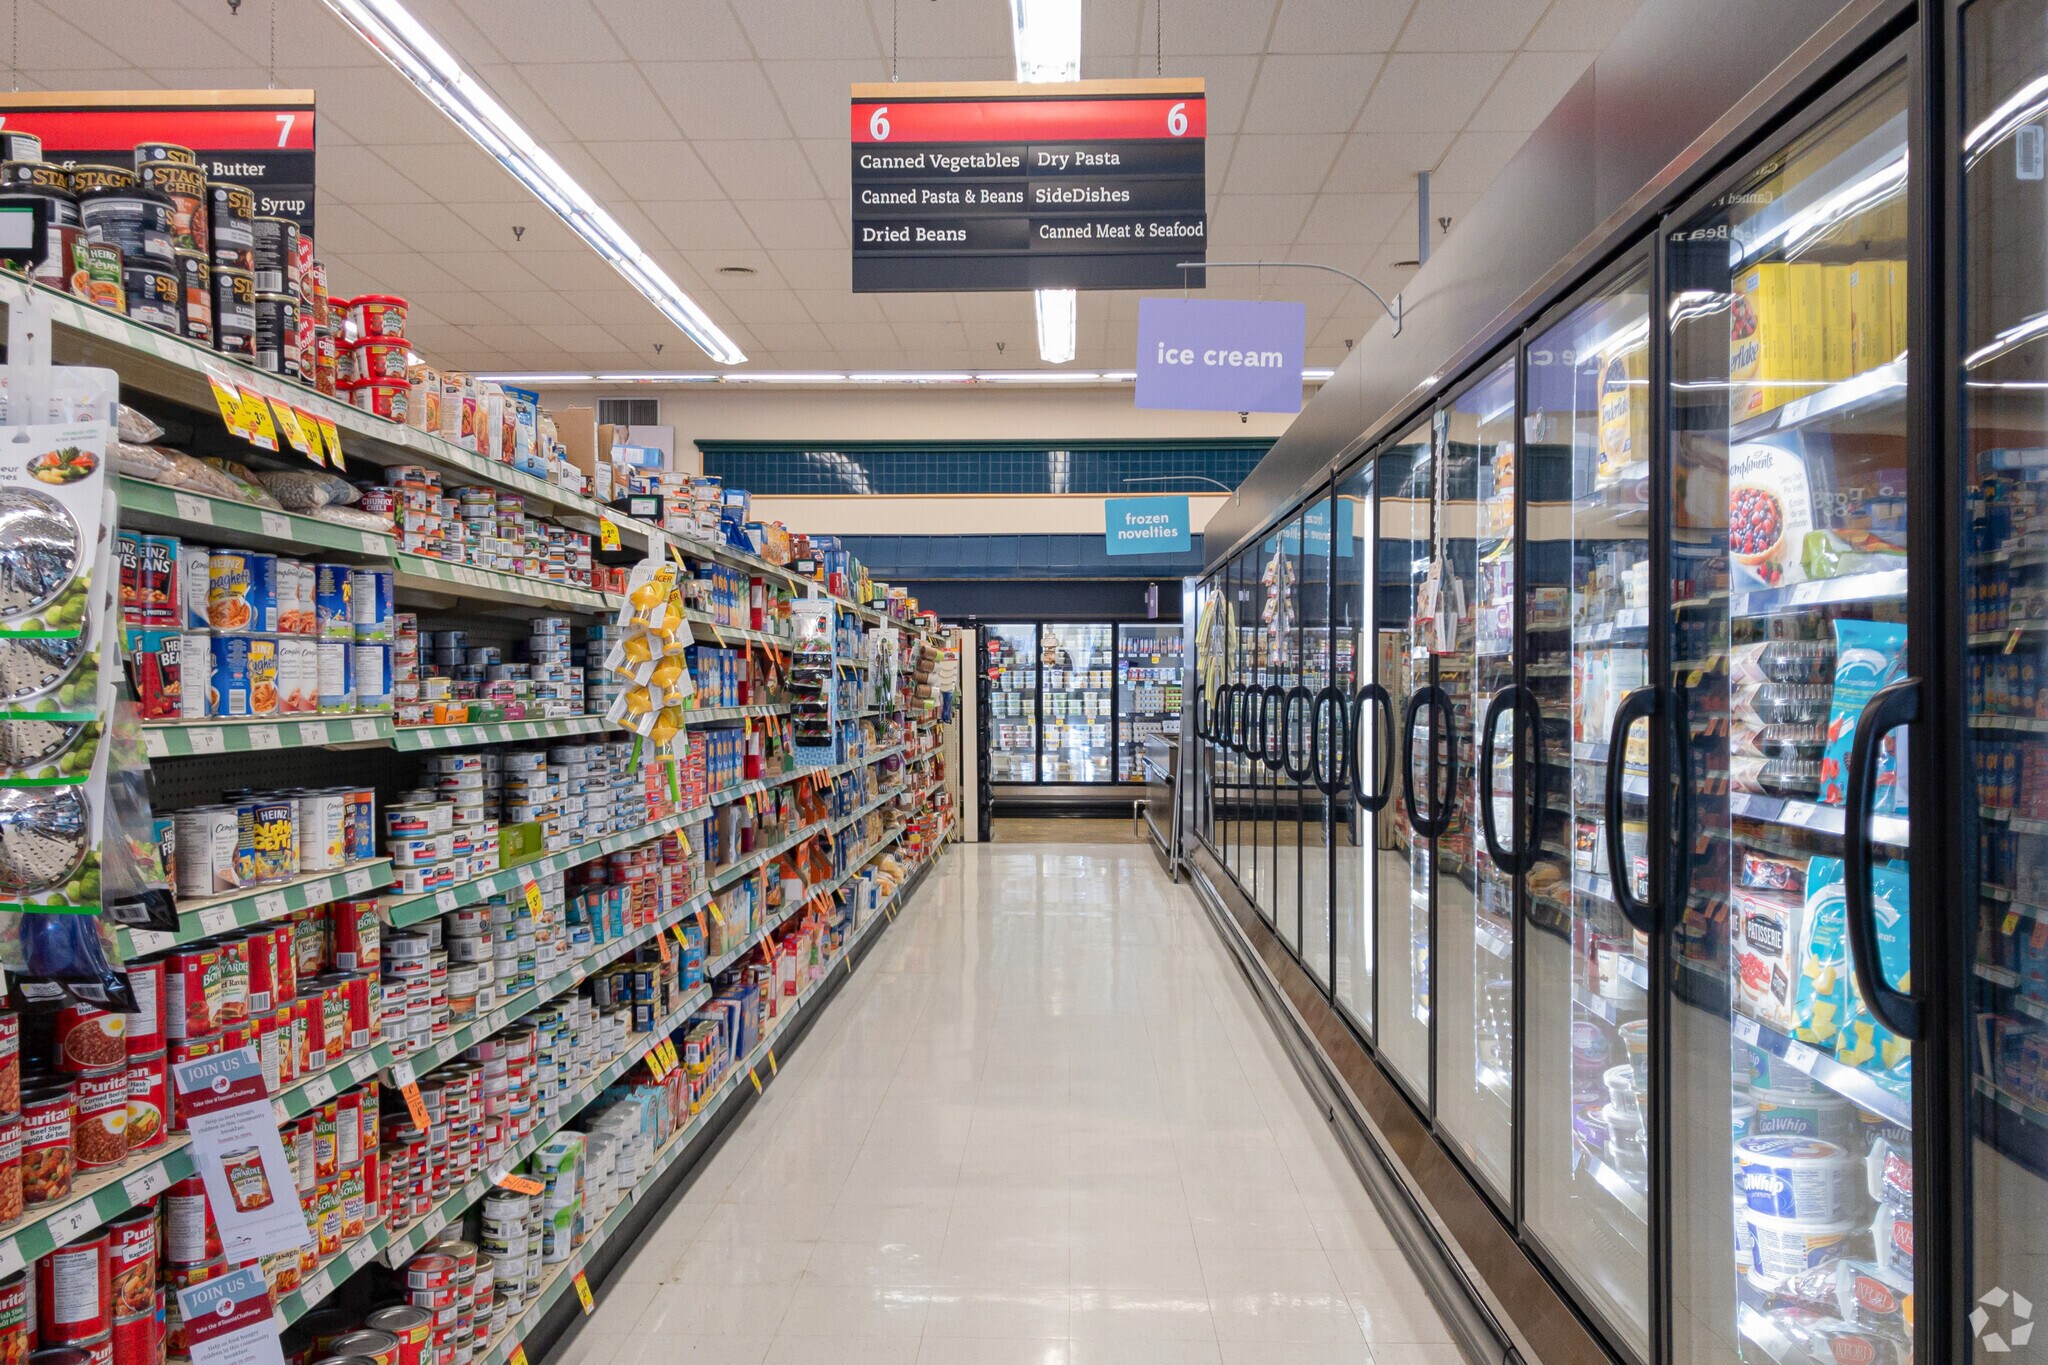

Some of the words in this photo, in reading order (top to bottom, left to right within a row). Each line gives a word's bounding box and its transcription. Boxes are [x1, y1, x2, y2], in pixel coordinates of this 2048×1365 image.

[869, 107, 890, 140] 6
[1167, 102, 1188, 136] 6
[276, 114, 295, 148] 7
[213, 162, 266, 177] Butter
[860, 155, 925, 169] Canned
[929, 153, 1020, 172] Vegetables
[1038, 152, 1070, 171] Dry
[1075, 152, 1120, 166] Pasta
[862, 190, 917, 204] Canned
[921, 190, 960, 204] Pasta
[964, 190, 976, 204] &
[981, 190, 1024, 204] Beans
[1036, 187, 1130, 203] SideDishes
[261, 197, 306, 216] Syrup
[863, 226, 911, 242] Dried
[915, 227, 967, 242] Beans
[1039, 224, 1092, 239] Canned
[1096, 223, 1130, 238] Meat
[1134, 223, 1145, 237] &
[1149, 221, 1204, 237] Seafood
[89, 250, 117, 261] HEINZ
[1157, 342, 1194, 365] ice
[1203, 348, 1283, 368] cream
[1730, 340, 1759, 373] erflake
[1729, 451, 1774, 479] ompliments
[362, 497, 392, 505] CHUNKY
[1125, 512, 1169, 525] frozen
[1118, 525, 1179, 540] novelties
[118, 541, 136, 555] INZ
[140, 546, 166, 559] EINZ
[143, 558, 171, 573] ANS
[646, 574, 672, 583] JUICER
[261, 809, 288, 821] HEINZ
[188, 1064, 219, 1083] JOIN
[221, 1057, 240, 1072] US
[80, 1076, 127, 1094] Purita
[84, 1093, 108, 1105] Corned
[82, 1103, 104, 1112] Hachis
[25, 1108, 70, 1126] uritan
[30, 1128, 47, 1136] Beef
[191, 1284, 223, 1308] JOIN
[226, 1278, 245, 1293] US
[196, 1326, 207, 1334] Take
[240, 1330, 259, 1340] hungry
[1833, 1338, 1873, 1359] OXFORD
